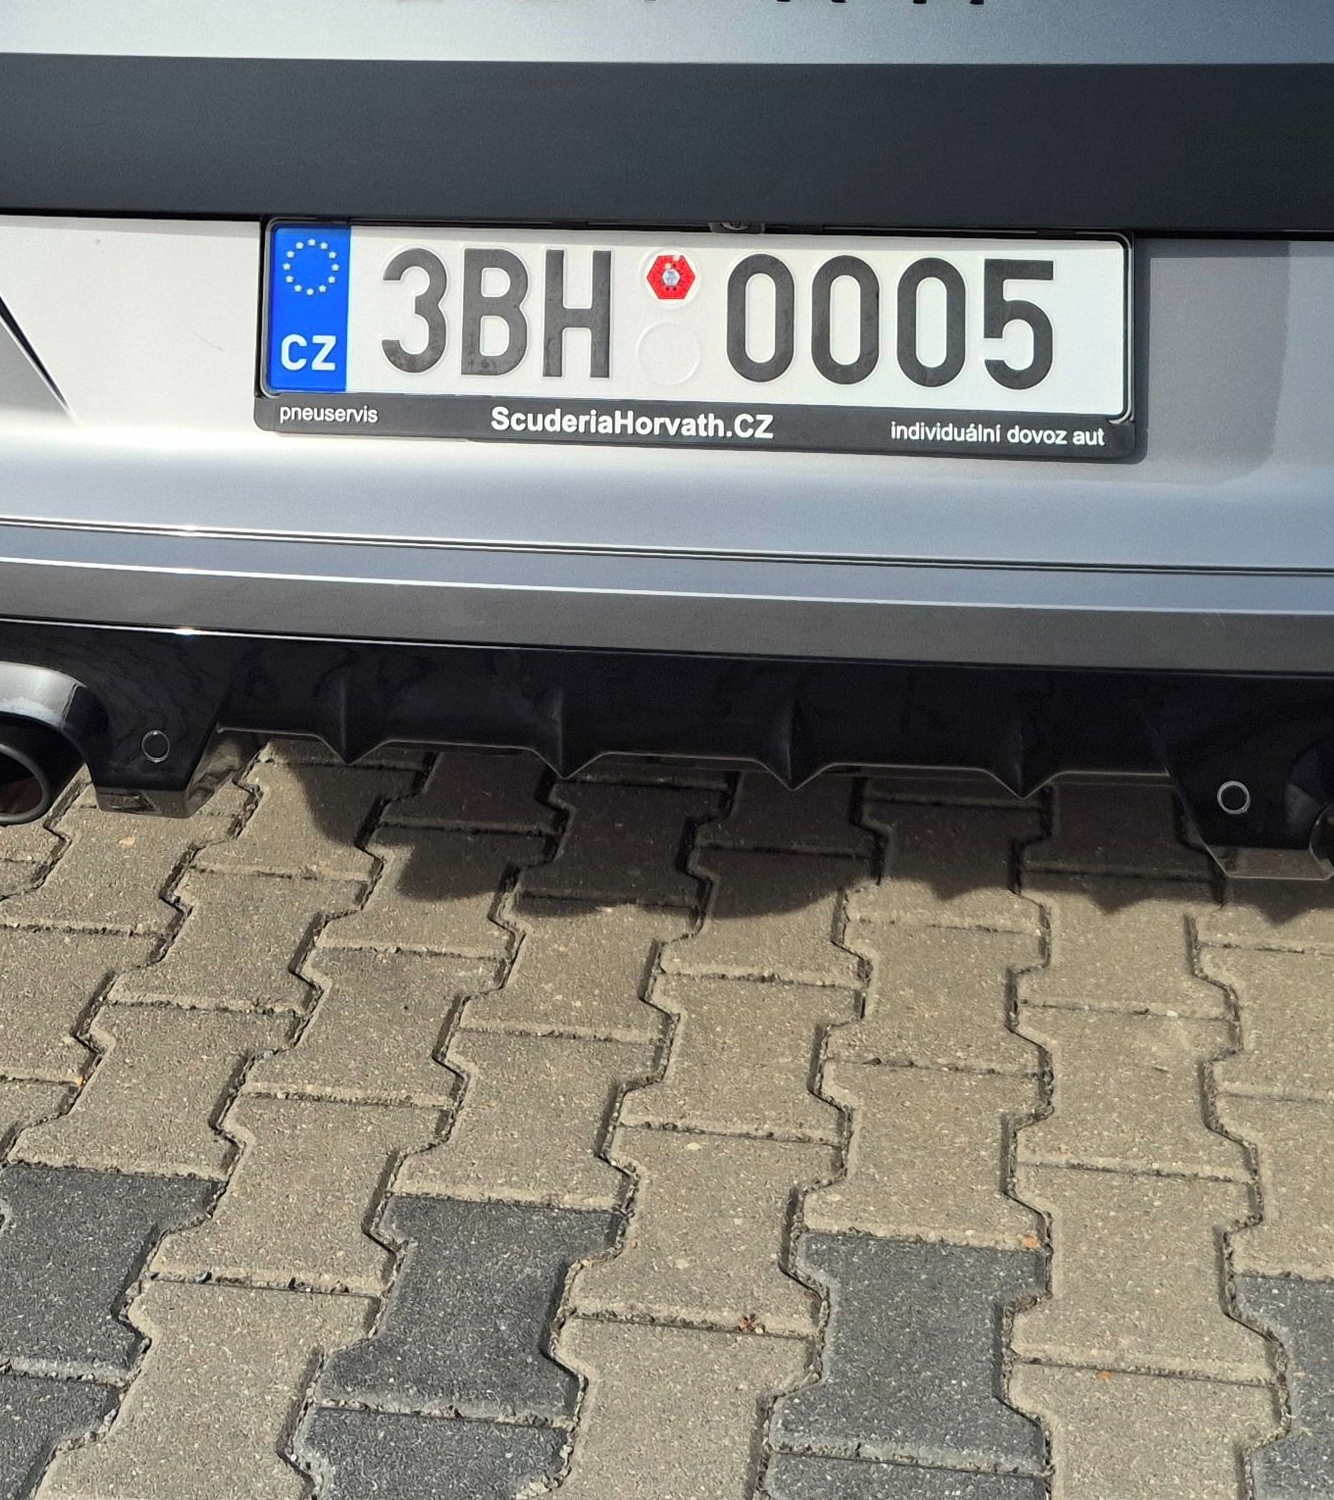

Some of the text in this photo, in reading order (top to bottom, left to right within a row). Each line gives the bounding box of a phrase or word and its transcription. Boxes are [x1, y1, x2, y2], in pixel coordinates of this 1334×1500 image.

[381, 247, 1056, 392] 3BH 0005
[280, 333, 337, 371] CZ
[279, 405, 379, 425] pneuservis
[490, 405, 775, 440] ScuderiaHorvath.CZ
[890, 421, 1106, 446] individuální dovoz aut
